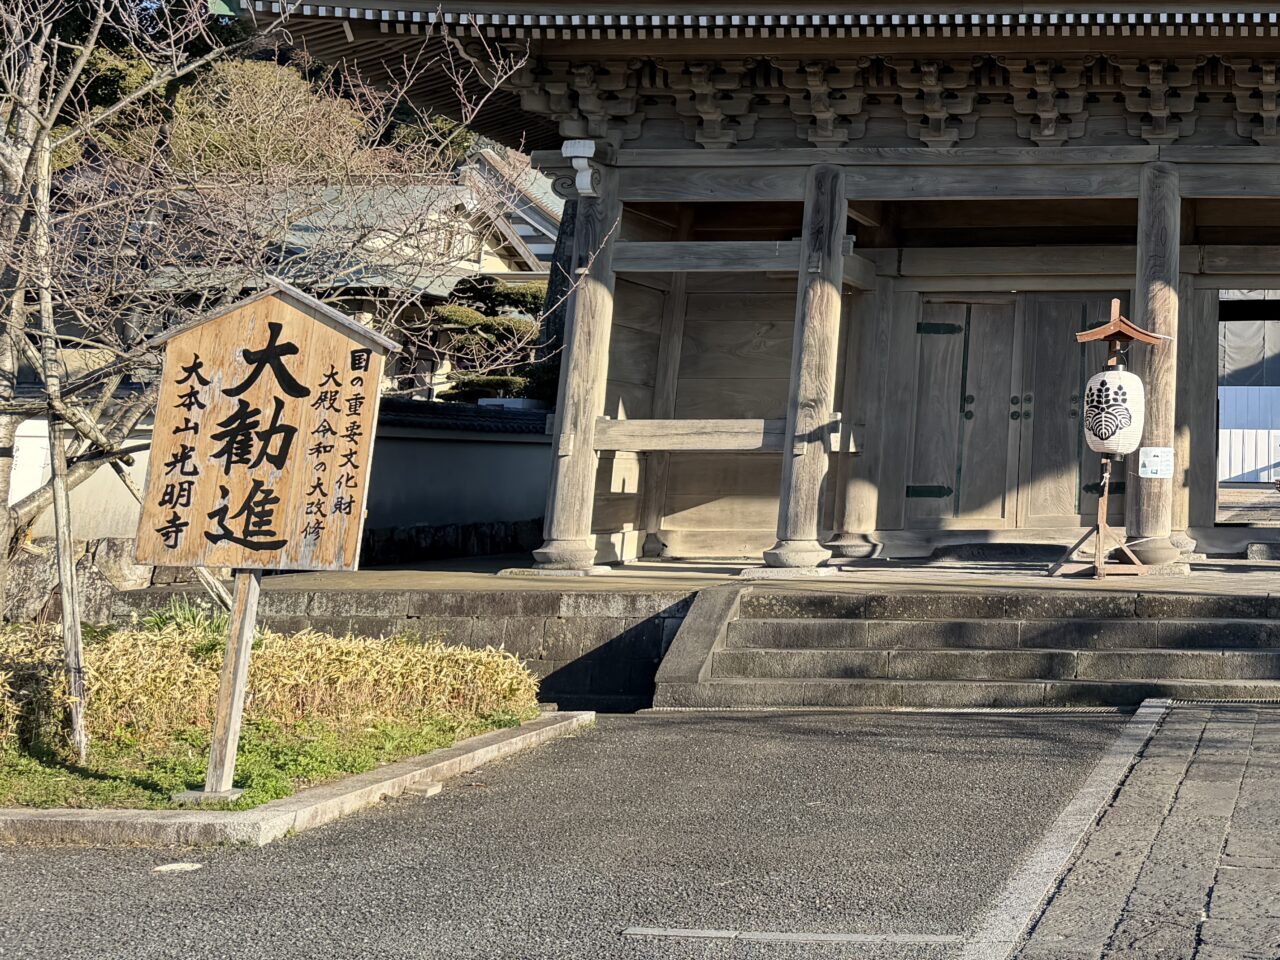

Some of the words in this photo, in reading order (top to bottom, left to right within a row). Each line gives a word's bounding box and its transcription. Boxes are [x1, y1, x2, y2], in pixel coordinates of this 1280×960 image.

[155, 353, 211, 549] 大本山光明寺
[204, 322, 311, 551] 大勧進
[301, 364, 343, 541] 大殿令和の大改修
[332, 348, 372, 516] 国の重要文化財
